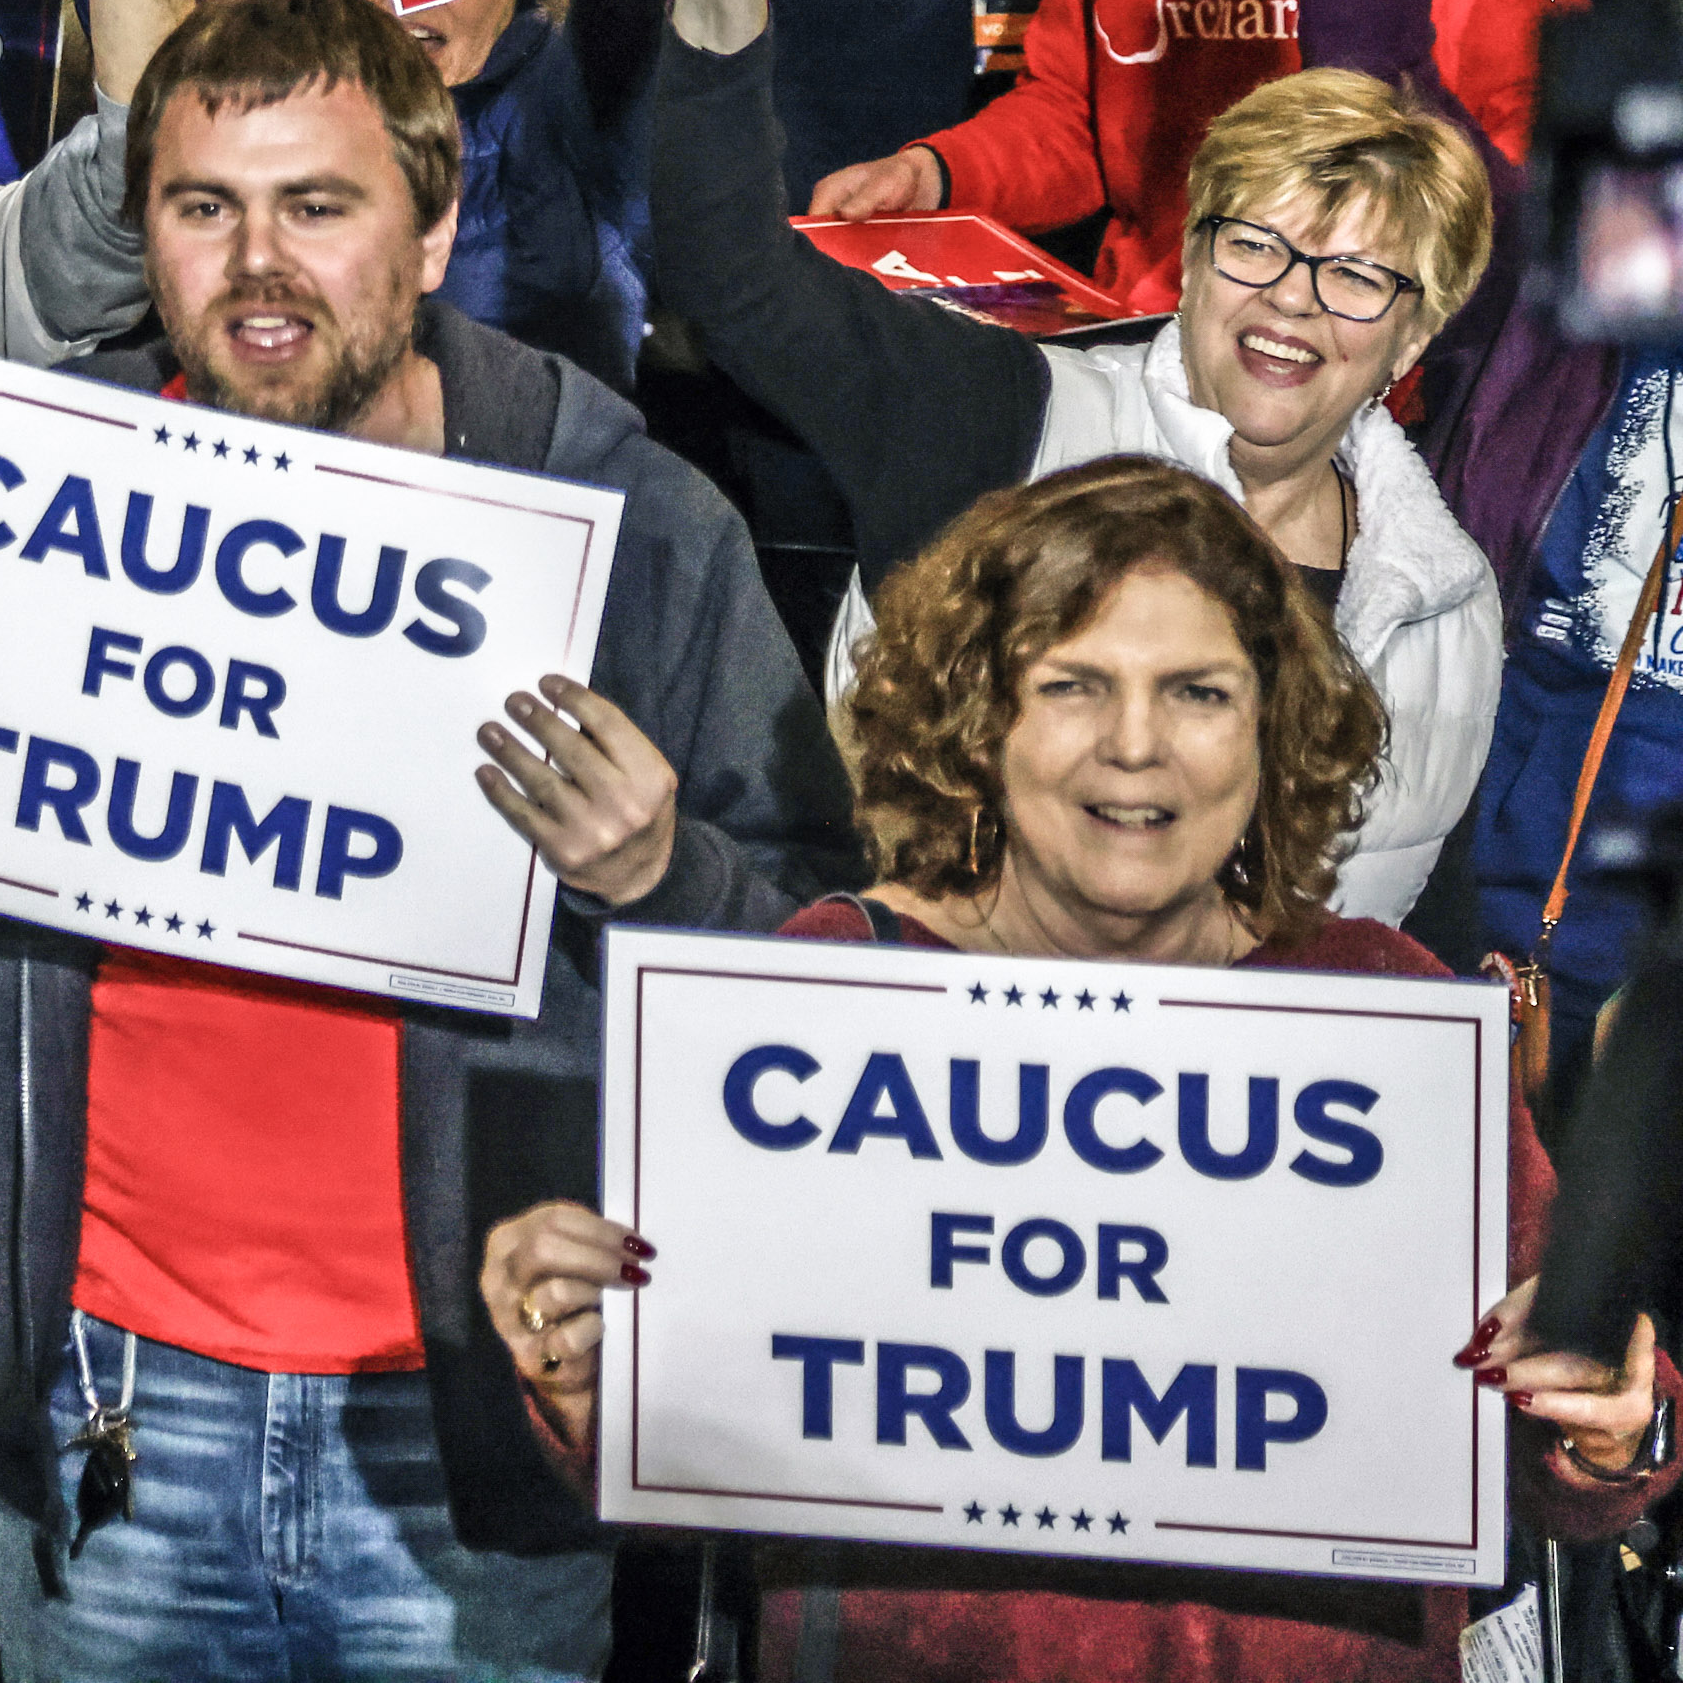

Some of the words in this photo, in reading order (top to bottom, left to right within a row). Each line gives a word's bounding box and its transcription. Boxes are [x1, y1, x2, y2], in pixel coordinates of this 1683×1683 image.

[82, 625, 287, 740] FOR
[722, 1043, 1384, 1187] CAUCUS
[930, 1212, 1170, 1305] FOR
[770, 1333, 1329, 1472] TRUMP
